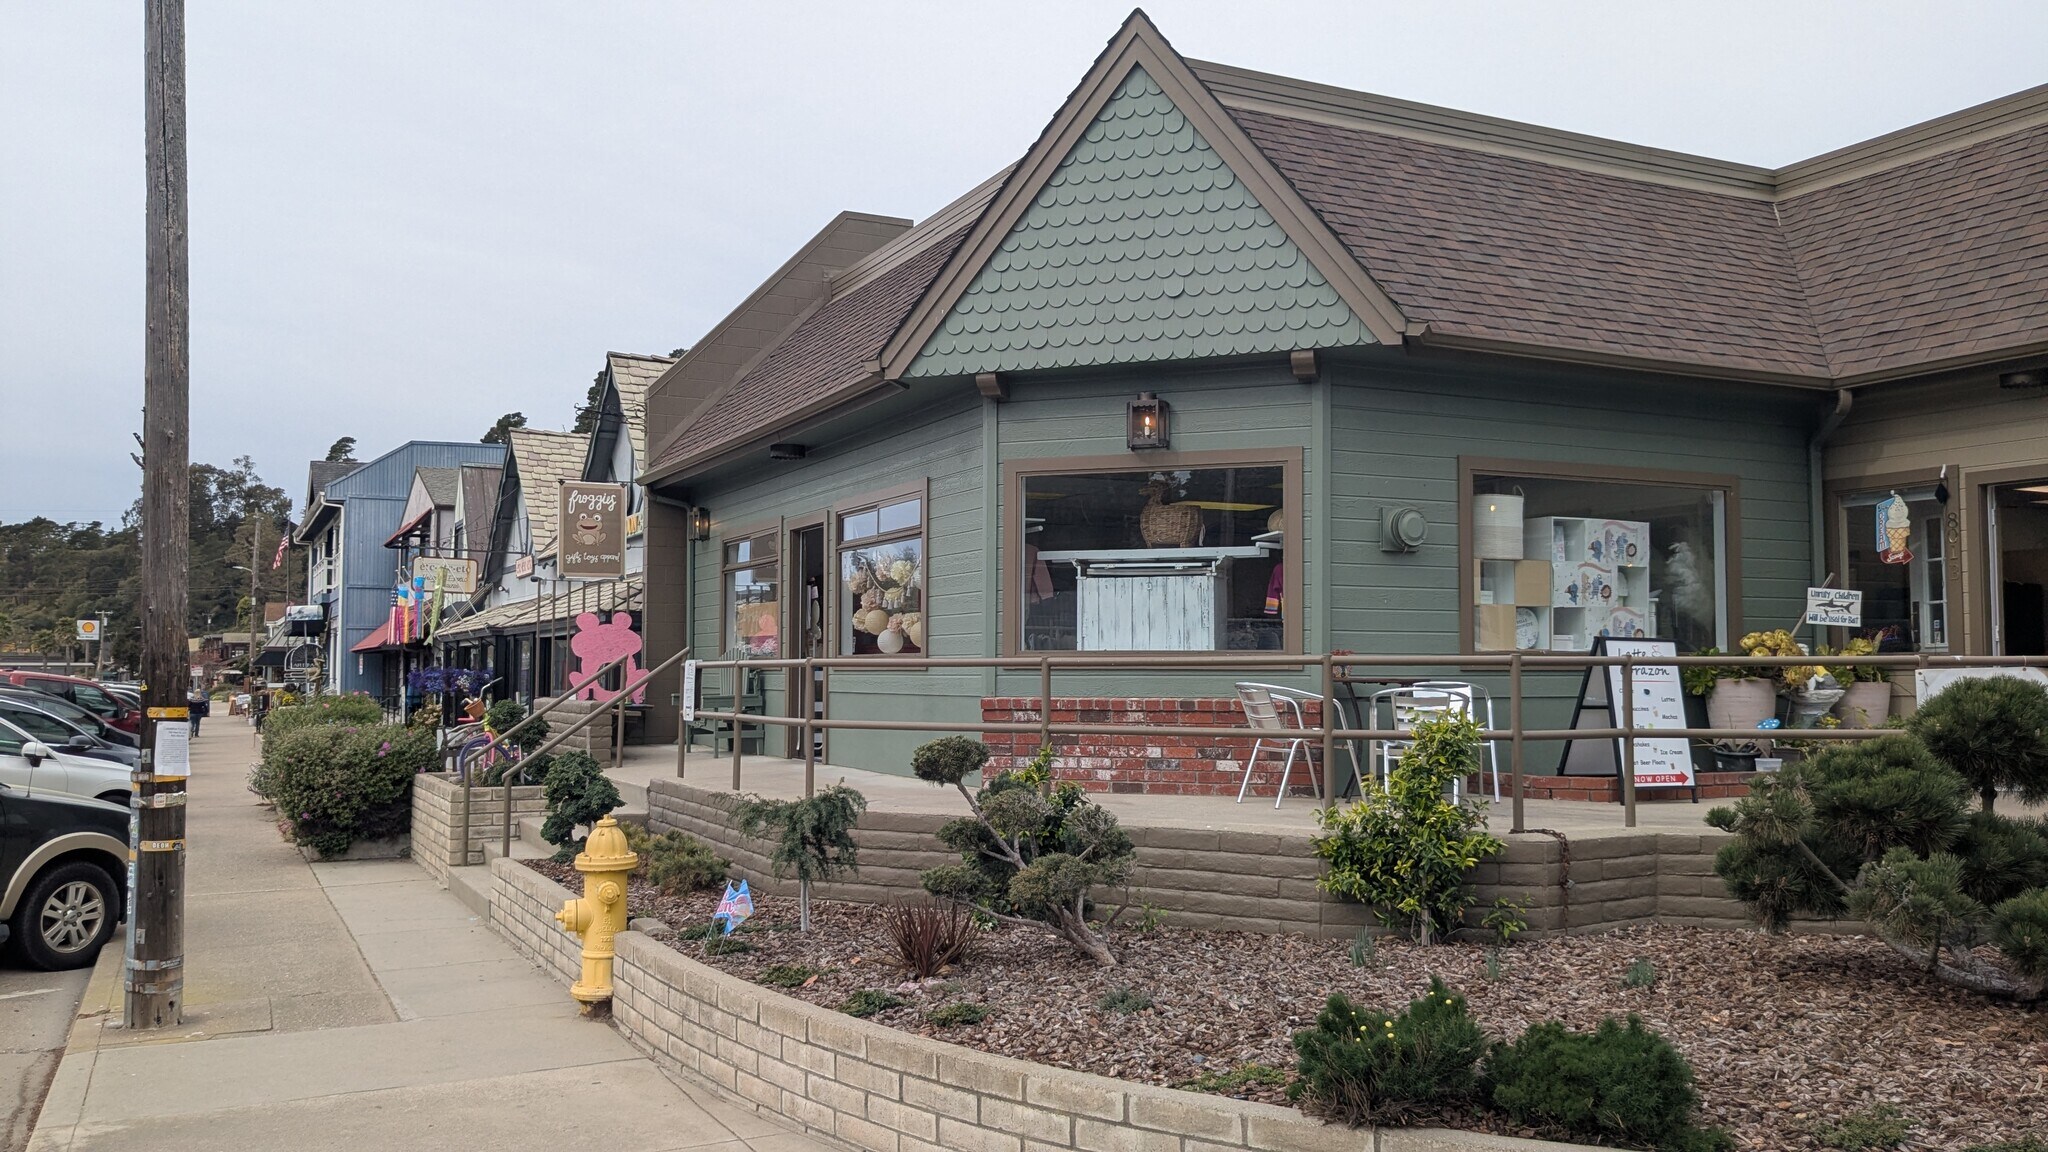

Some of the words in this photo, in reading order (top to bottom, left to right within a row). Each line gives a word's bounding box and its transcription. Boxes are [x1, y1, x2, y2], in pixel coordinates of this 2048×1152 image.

[568, 489, 617, 514] froggies
[583, 552, 599, 564] toys
[1834, 591, 1860, 600] Children
[1808, 613, 1819, 622] Will
[1819, 614, 1828, 623] be
[1840, 615, 1848, 623] for
[1848, 616, 1859, 624] Bait
[1655, 775, 1677, 783] OPEN
